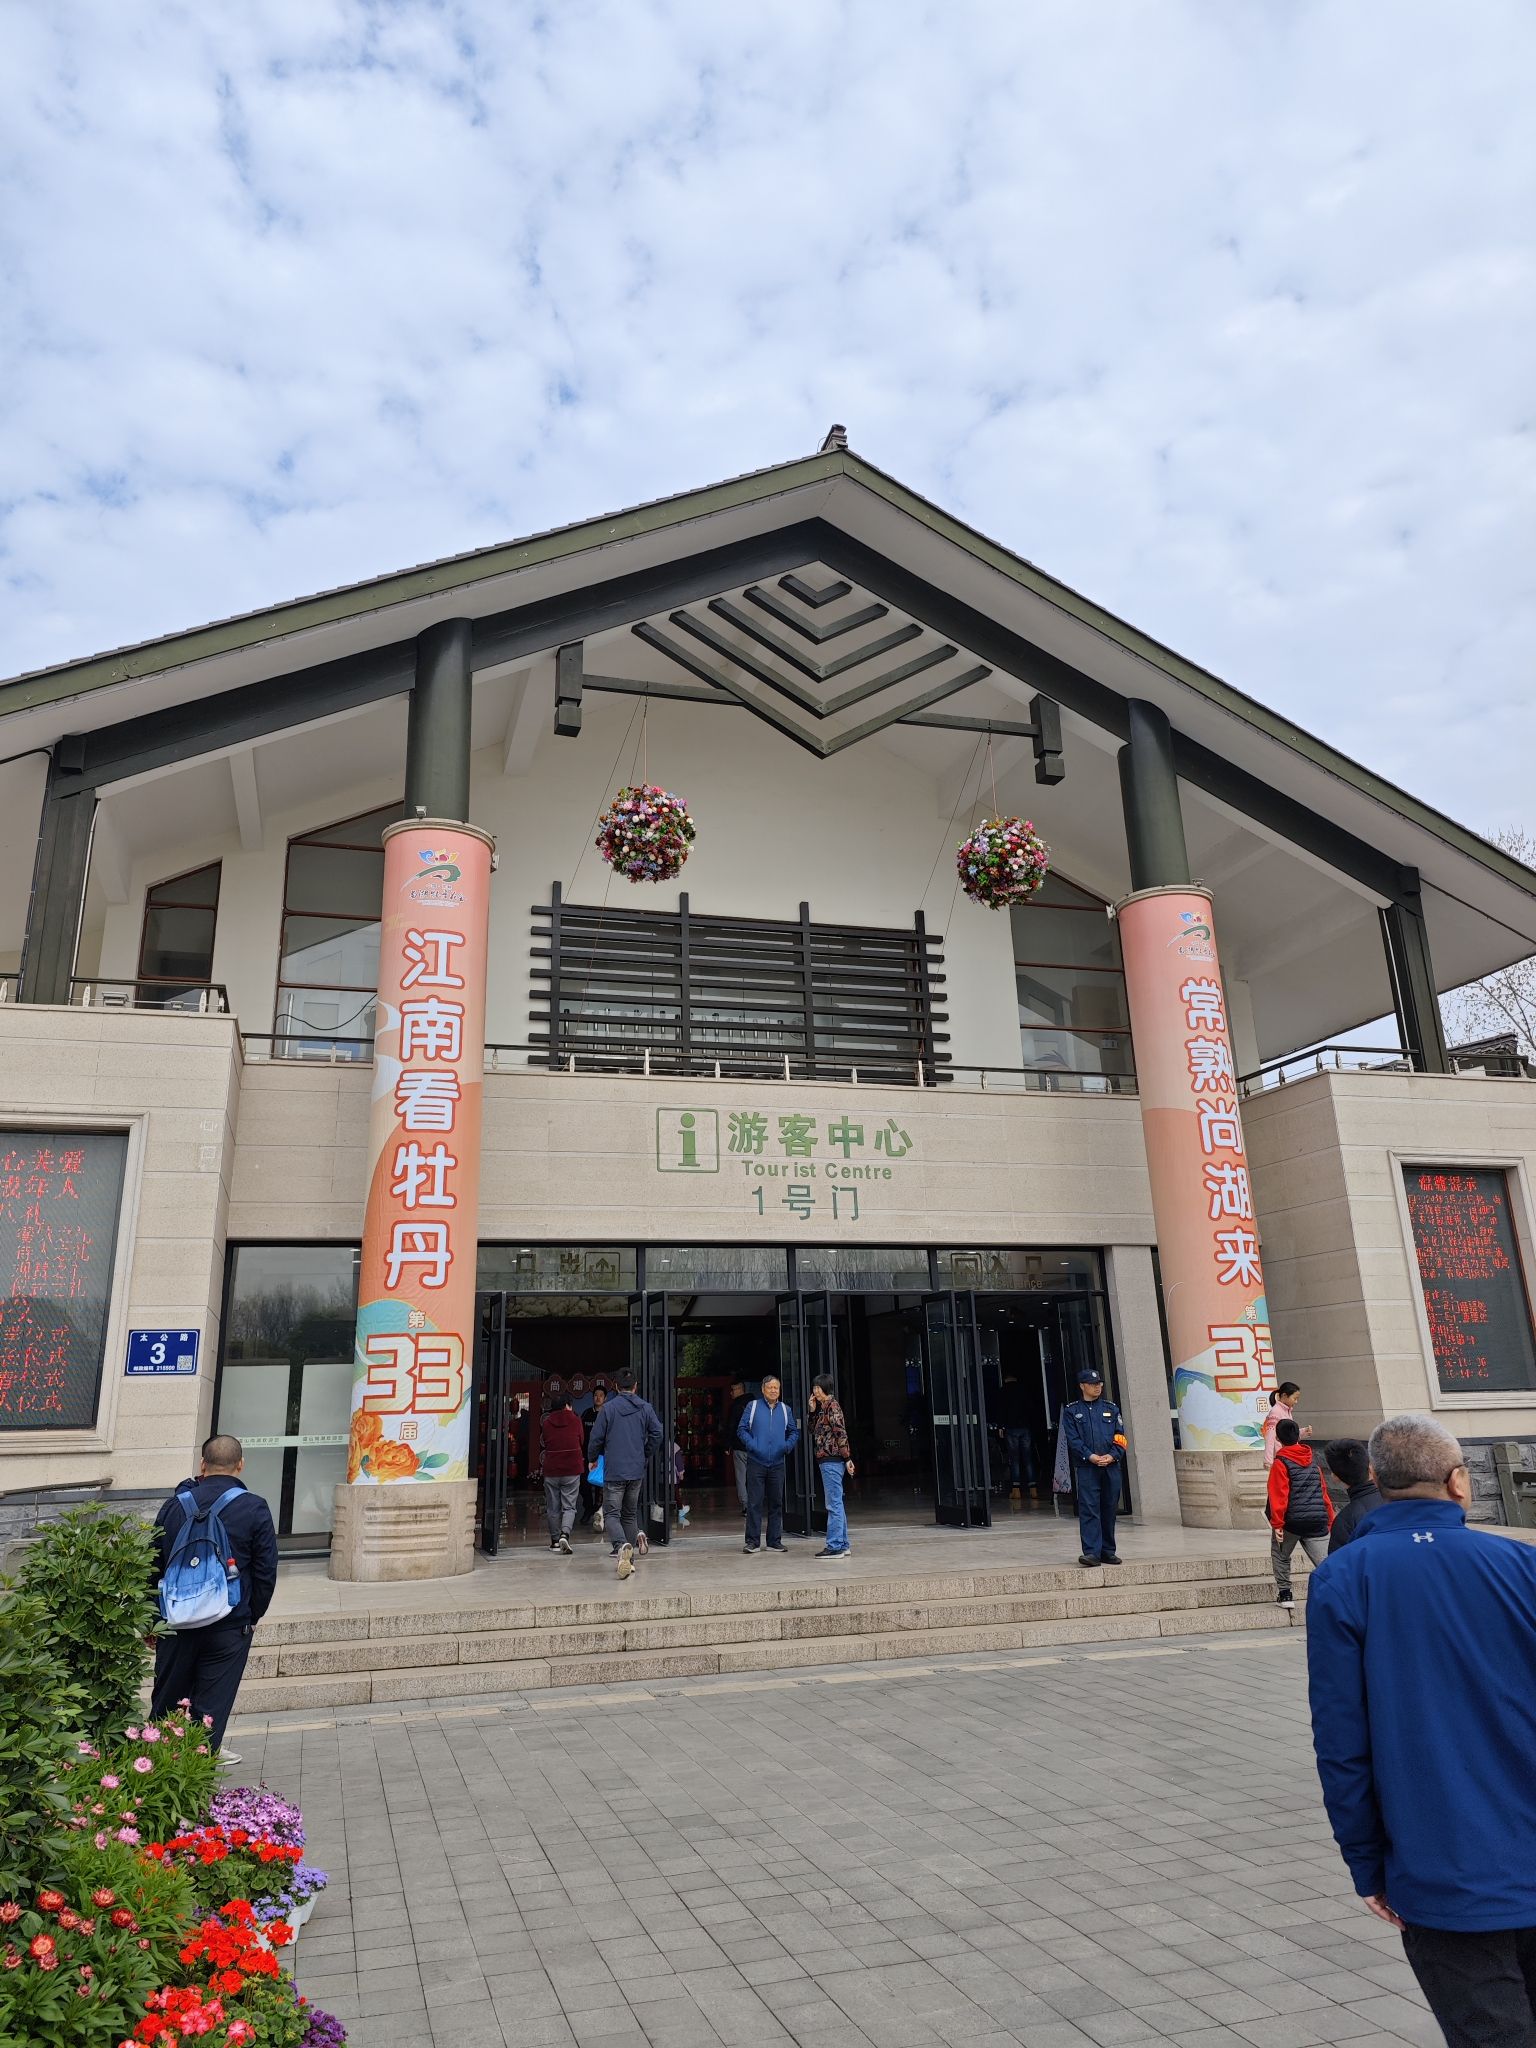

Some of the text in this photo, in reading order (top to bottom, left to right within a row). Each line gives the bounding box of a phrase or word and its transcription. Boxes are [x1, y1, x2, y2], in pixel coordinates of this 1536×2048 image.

[384, 928, 465, 1290] 江南看牡丹
[727, 1111, 913, 1159] 游客中心
[1179, 977, 1262, 1287] 常熟尚湖来
[741, 1160, 892, 1180] Tourist Centre
[751, 1184, 860, 1221] 1号门
[409, 1311, 425, 1328] 第
[140, 1333, 188, 1342] 太公路
[150, 1342, 166, 1365] 3
[362, 1333, 465, 1415] 33
[400, 1422, 418, 1441] 届
